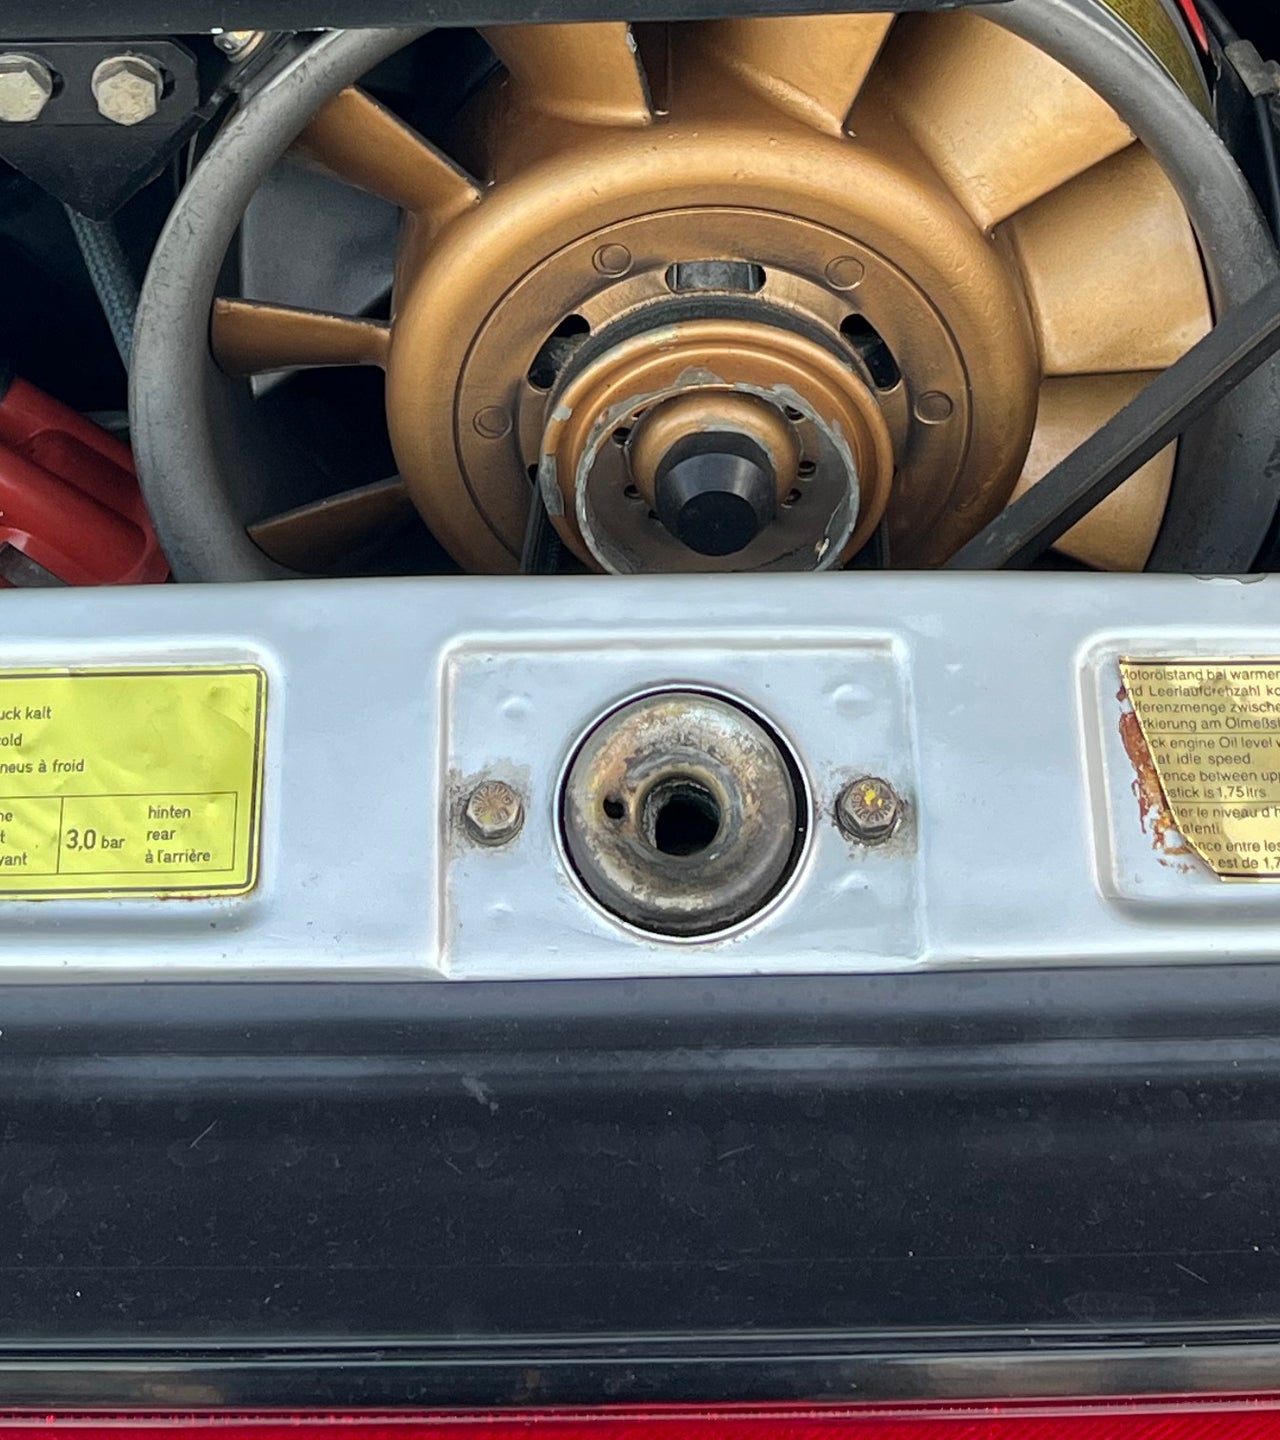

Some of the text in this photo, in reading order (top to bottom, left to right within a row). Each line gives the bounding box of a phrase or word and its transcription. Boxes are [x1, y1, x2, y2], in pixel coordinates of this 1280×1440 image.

[1126, 685, 1143, 696] nd
[1148, 684, 1261, 697] Leerlaufdrehzahl
[25, 706, 52, 720] kalt
[1141, 717, 1197, 731] rkierung
[1200, 719, 1220, 729] am
[1169, 738, 1216, 752] engine
[1219, 737, 1238, 749] Oil
[1241, 737, 1273, 748] level
[38, 760, 47, 773] à
[52, 758, 85, 773] froid
[1176, 753, 1202, 765] idle
[1199, 769, 1258, 781] between
[1203, 786, 1215, 798] is
[148, 805, 191, 819] hinten
[1197, 806, 1209, 817] le
[1212, 806, 1258, 818] niveau
[65, 828, 125, 851] 3,0 bar
[146, 829, 176, 841] rear
[1225, 840, 1261, 852] entre
[1264, 840, 1280, 851] les
[144, 849, 211, 863] à l'arrière
[1219, 857, 1238, 869] est
[1241, 857, 1259, 869] de
